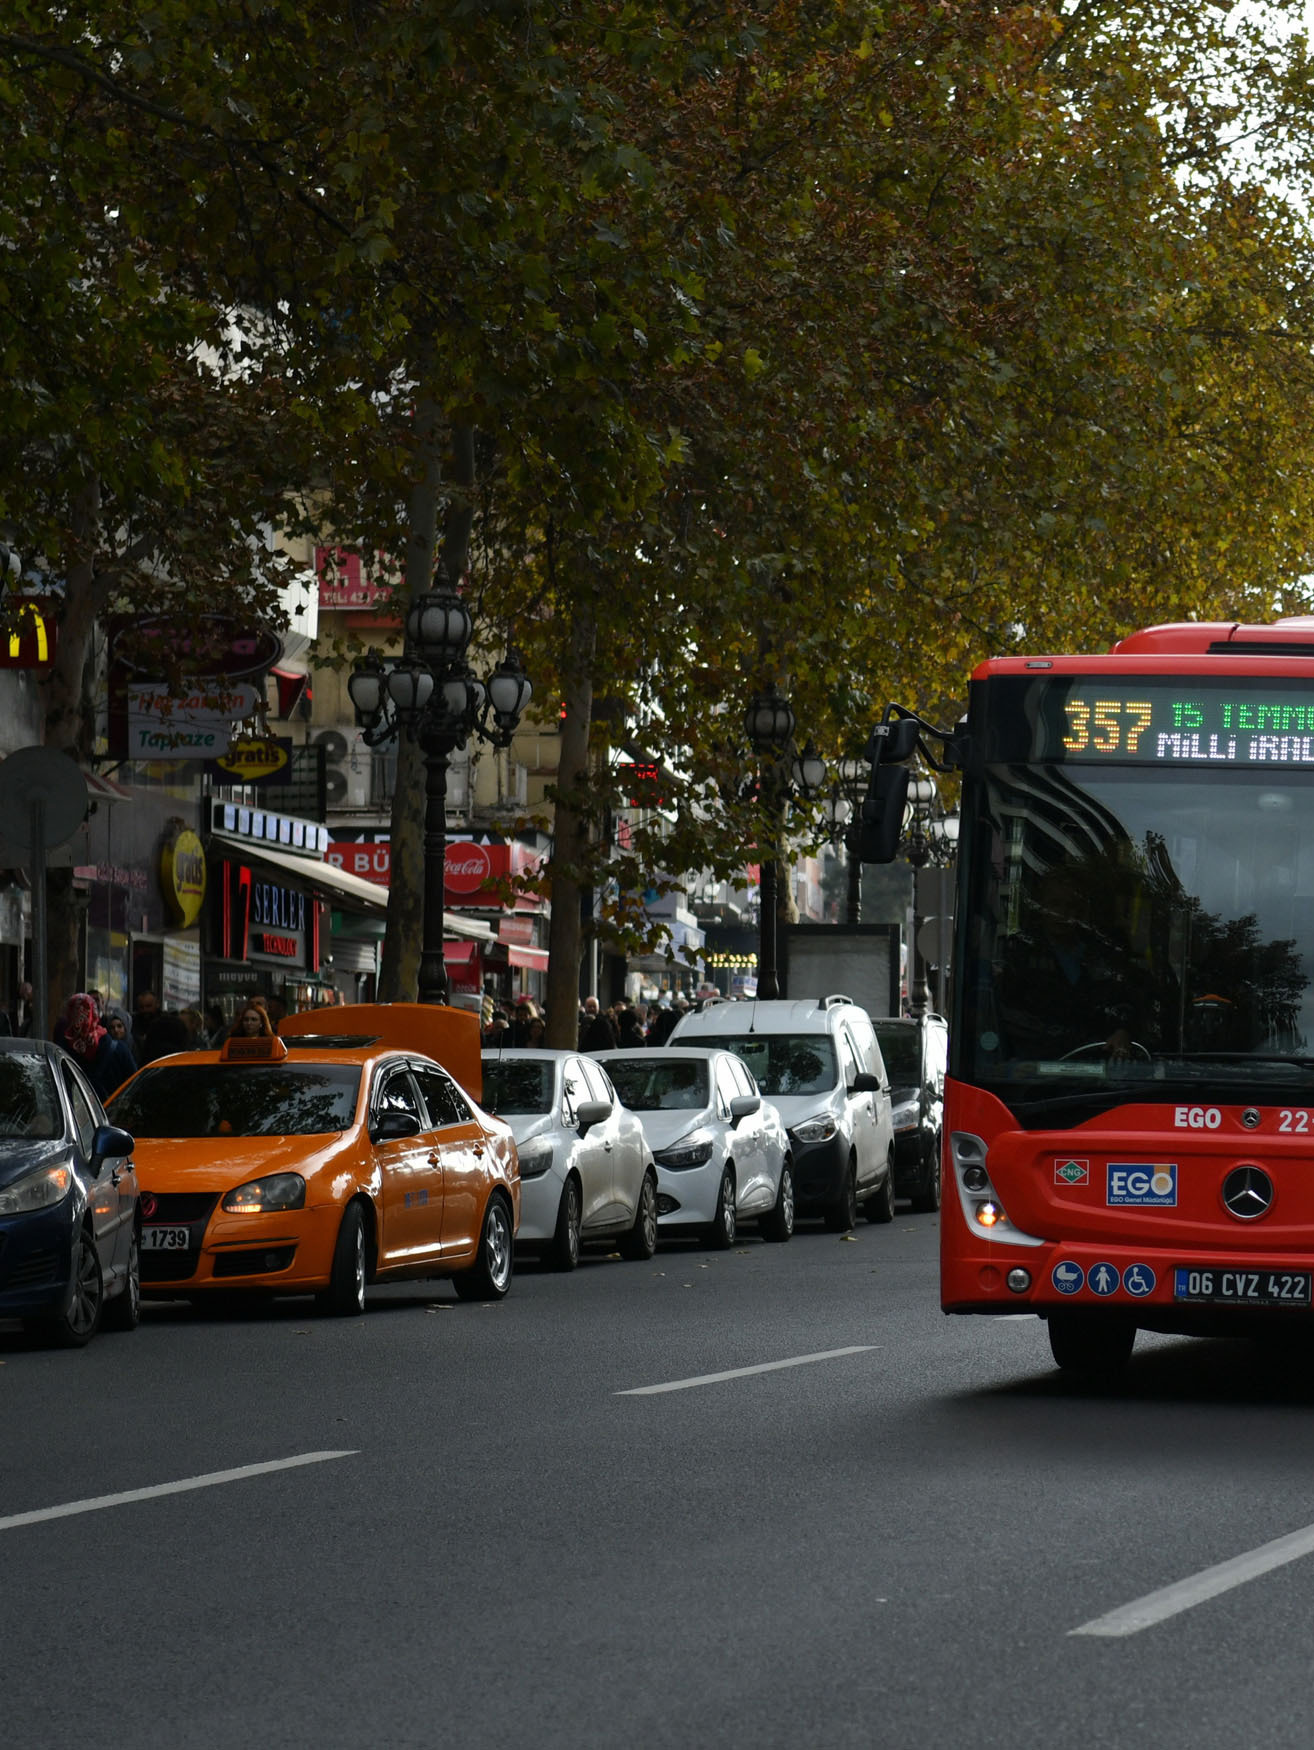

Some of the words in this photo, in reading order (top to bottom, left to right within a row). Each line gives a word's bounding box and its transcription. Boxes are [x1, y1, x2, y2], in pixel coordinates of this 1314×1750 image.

[1062, 700, 1152, 752] 357
[1172, 702, 1204, 728] 15
[255, 883, 306, 931] SERLER
[1174, 1107, 1222, 1129] EGO
[1060, 1168, 1081, 1176] CNG
[1111, 1172, 1174, 1196] EGO
[151, 1230, 187, 1247] 1739
[1189, 1272, 1213, 1295] 06
[1222, 1273, 1260, 1296] CVZ
[1268, 1275, 1305, 1298] 422
